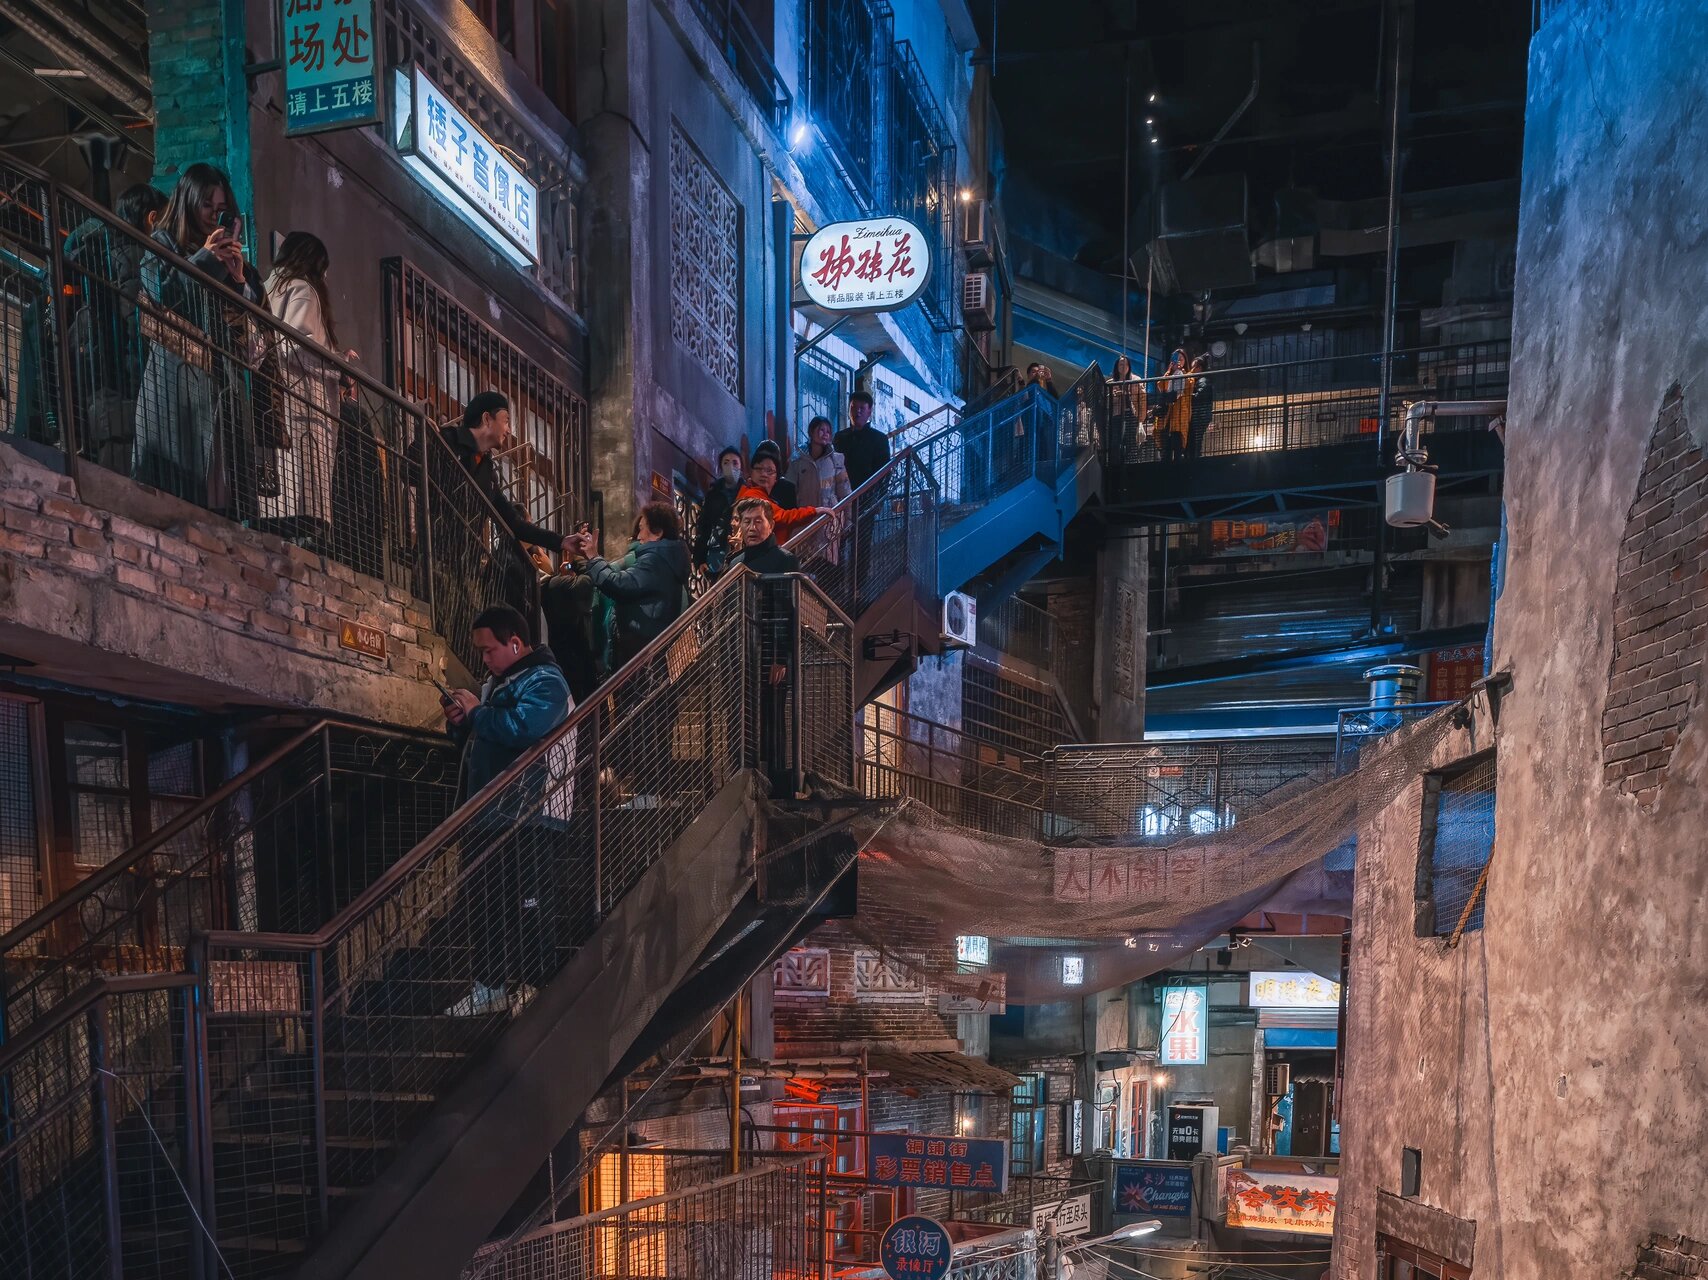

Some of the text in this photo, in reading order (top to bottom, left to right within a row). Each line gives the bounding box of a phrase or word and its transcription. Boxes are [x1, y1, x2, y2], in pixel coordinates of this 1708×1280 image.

[288, 80, 372, 116] 请上五楼
[427, 93, 530, 231] 矮子音像店
[827, 288, 904, 304] 精品服装 请上五楼
[1169, 1010, 1198, 1060] 水果
[906, 1139, 968, 1157] 铜铺街
[874, 1155, 997, 1187] 彩票销售点
[1142, 1186, 1189, 1203] Changsha
[1284, 1218, 1325, 1229] 健康休闲
[891, 1228, 942, 1257] 银河
[896, 1256, 935, 1274] 录像厅
